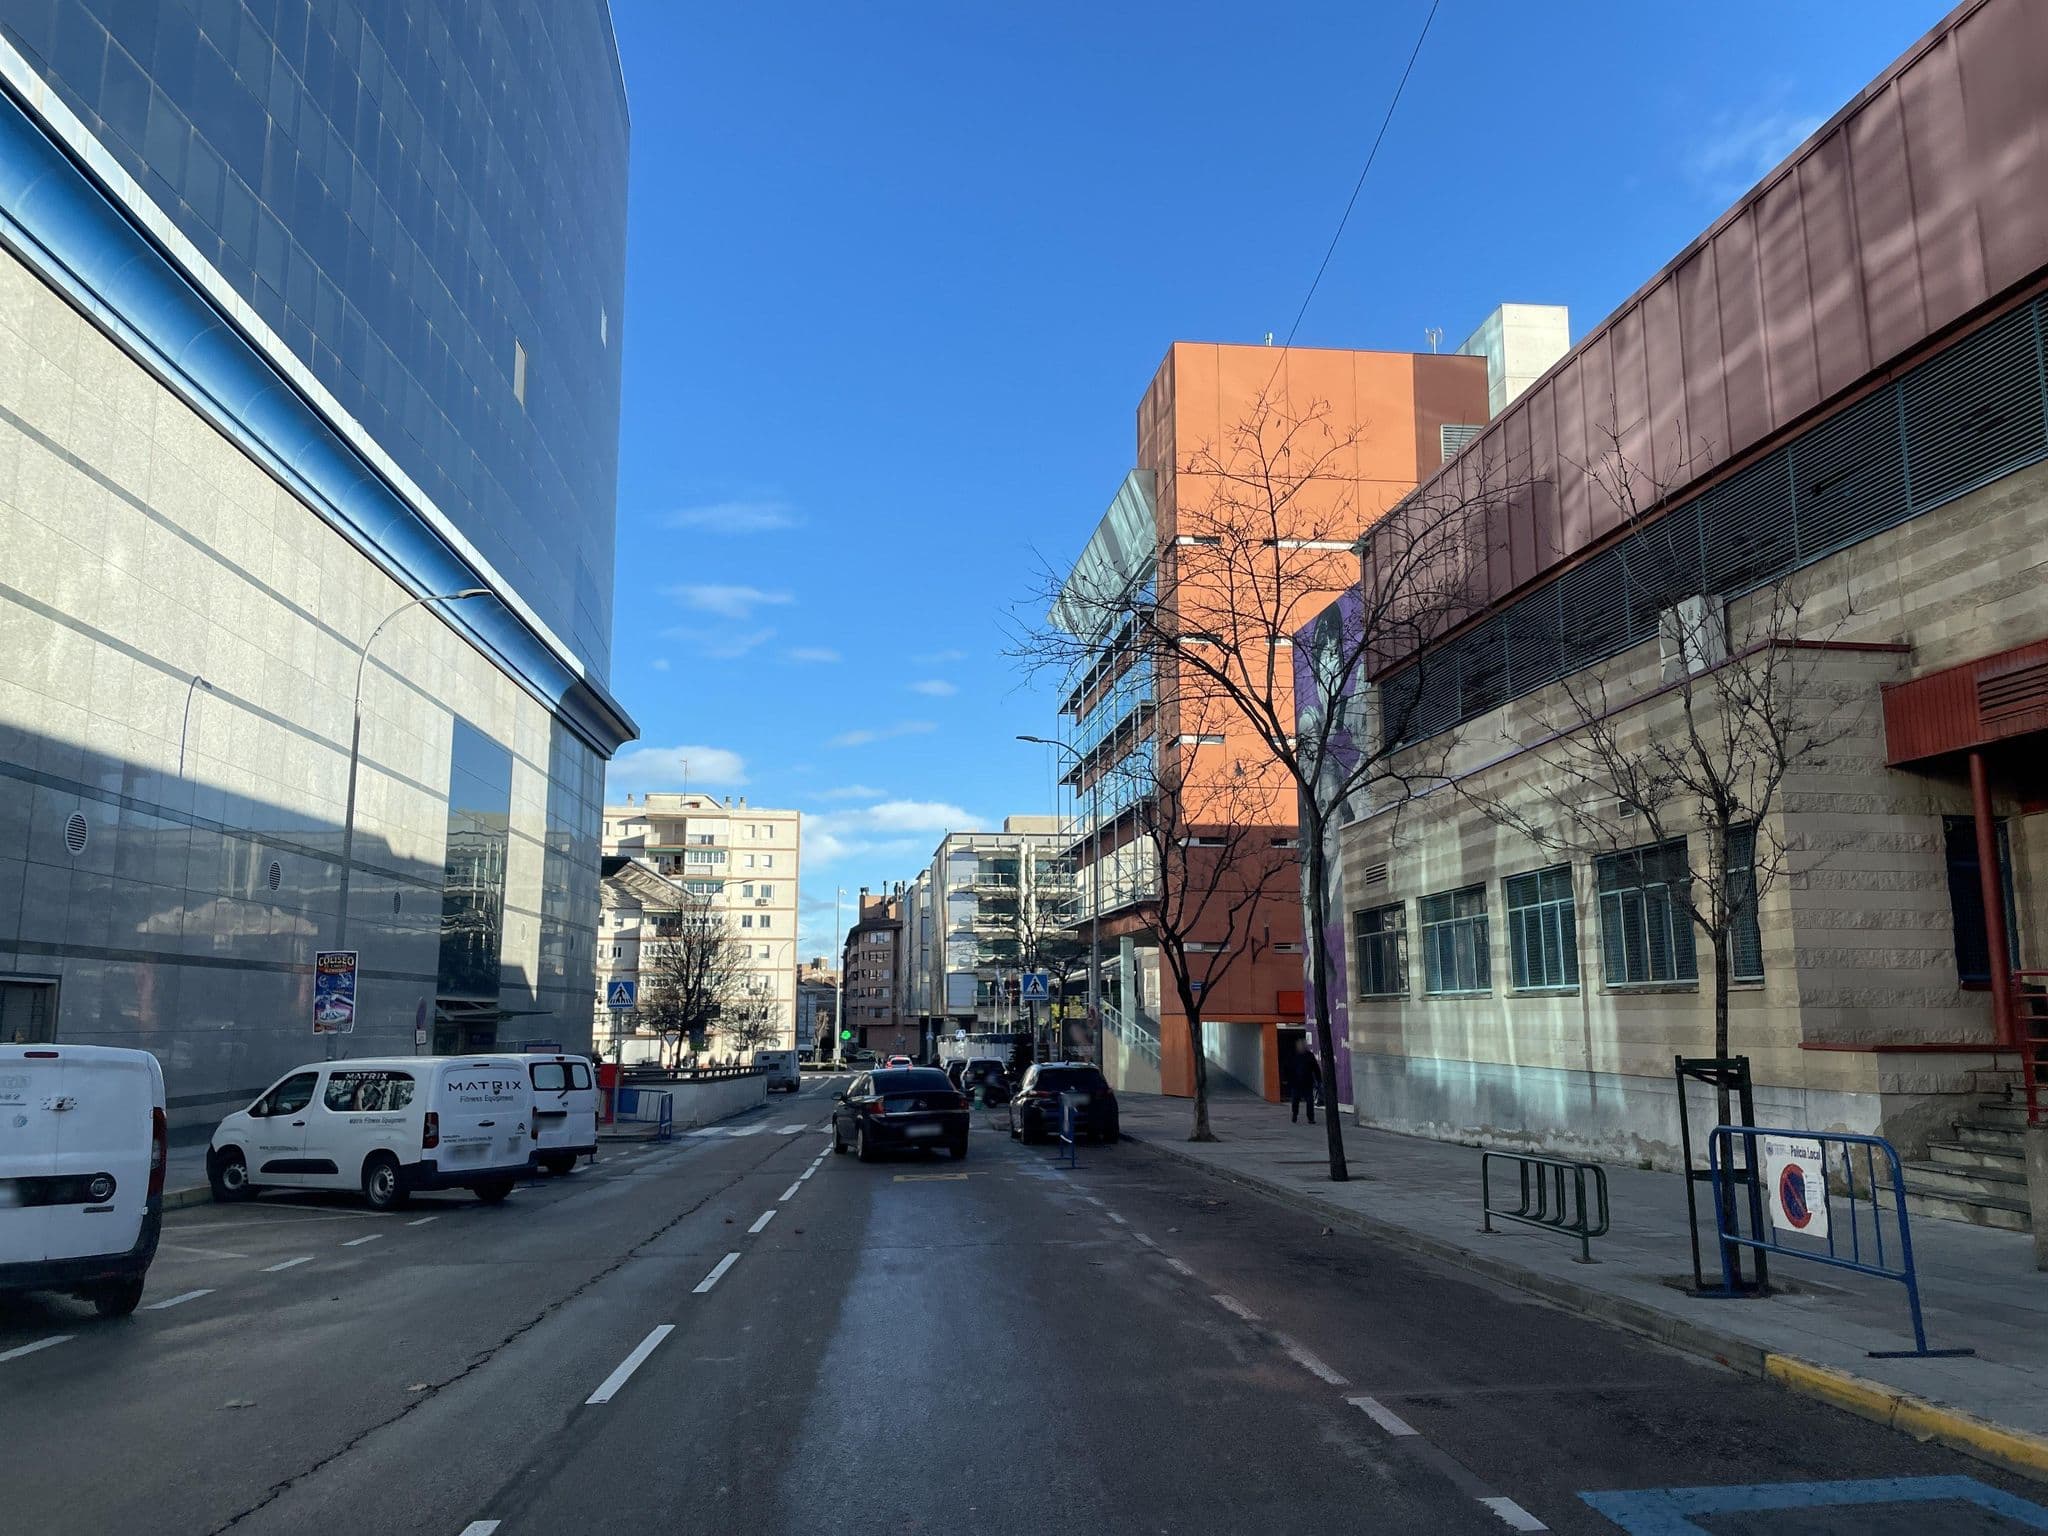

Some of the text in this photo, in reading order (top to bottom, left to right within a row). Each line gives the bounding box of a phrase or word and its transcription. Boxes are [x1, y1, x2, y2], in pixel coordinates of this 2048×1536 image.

[318, 956, 355, 968] COLISEO
[345, 1072, 389, 1081] MATRIX
[448, 1080, 522, 1092] MATRIX
